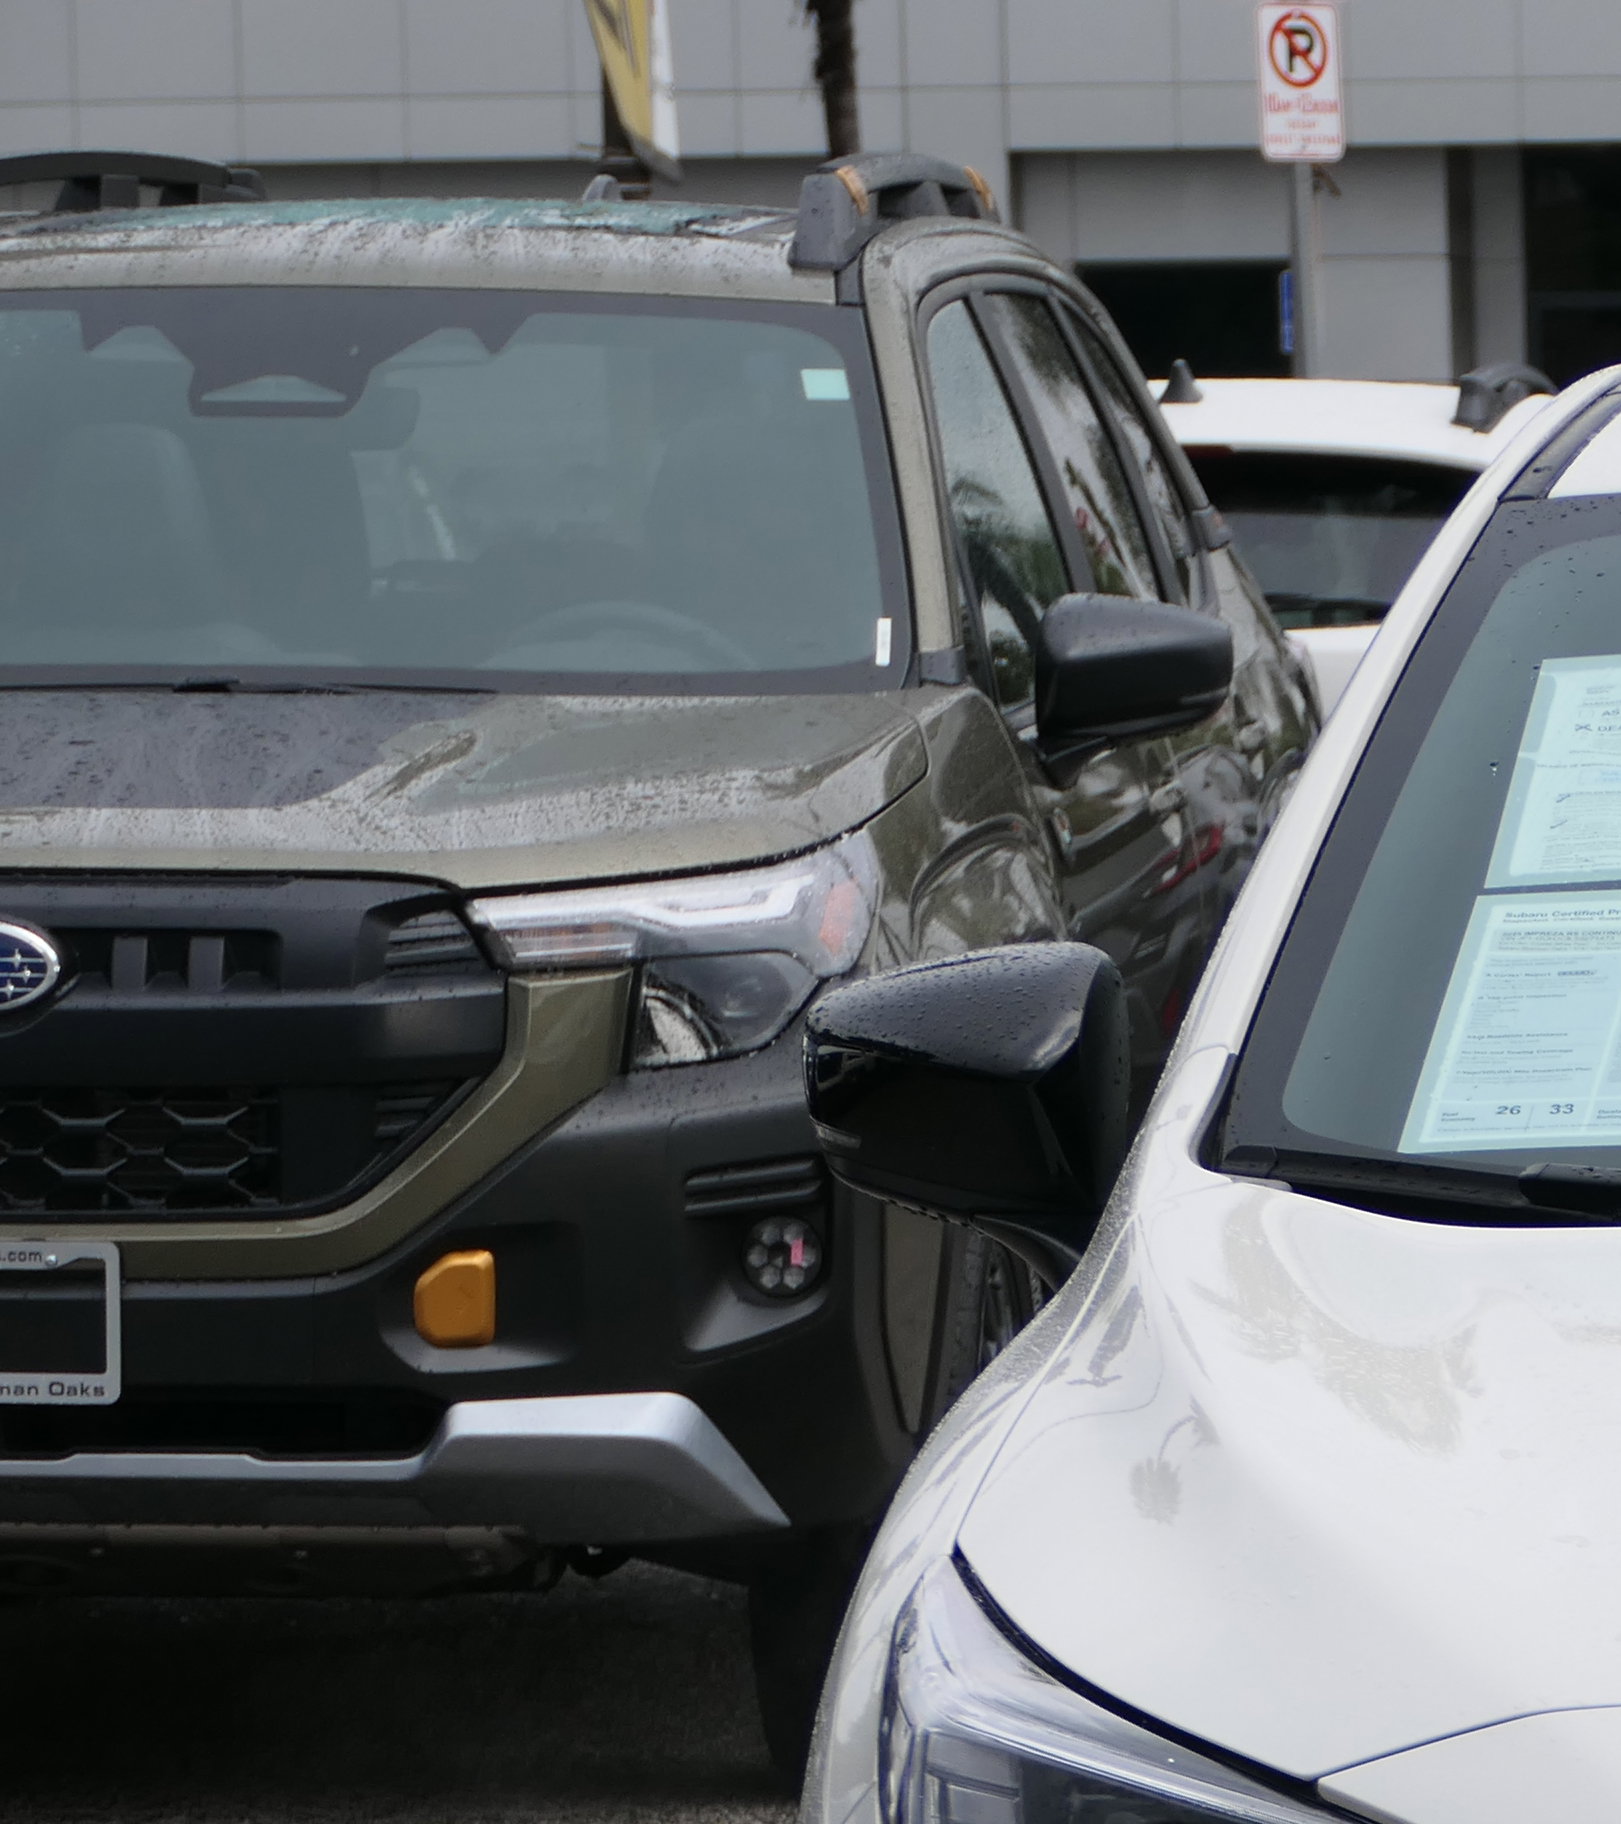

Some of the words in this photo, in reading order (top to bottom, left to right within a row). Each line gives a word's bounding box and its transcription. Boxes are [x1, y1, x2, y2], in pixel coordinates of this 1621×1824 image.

[1601, 708, 1620, 717] AS
[1552, 909, 1604, 917] Certified
[1496, 1104, 1522, 1115] 26
[1549, 1103, 1575, 1115] 33
[0, 1251, 42, 1263] .com
[49, 1382, 105, 1397] Oaks
